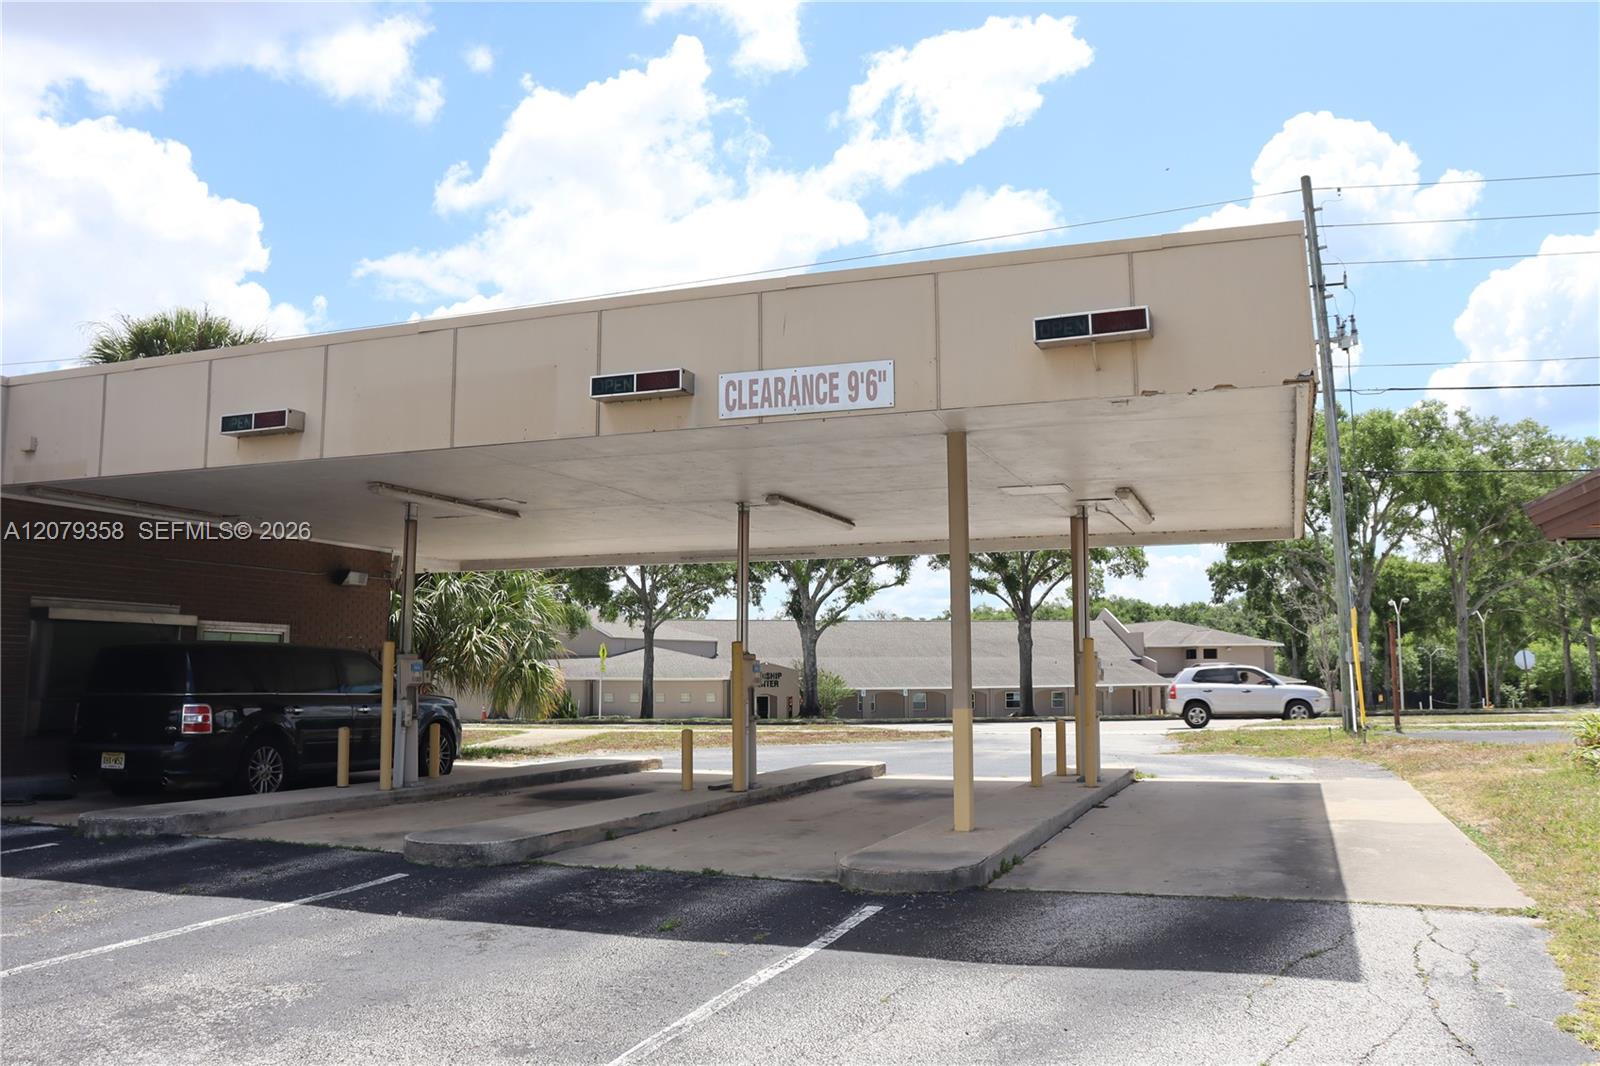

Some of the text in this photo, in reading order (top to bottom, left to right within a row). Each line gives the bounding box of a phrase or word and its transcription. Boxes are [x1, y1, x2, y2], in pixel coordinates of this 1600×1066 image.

[1039, 318, 1087, 338] OPEN
[593, 376, 633, 394] OPEN
[724, 371, 840, 412] CLEARANCE
[847, 368, 887, 403] 9'6"
